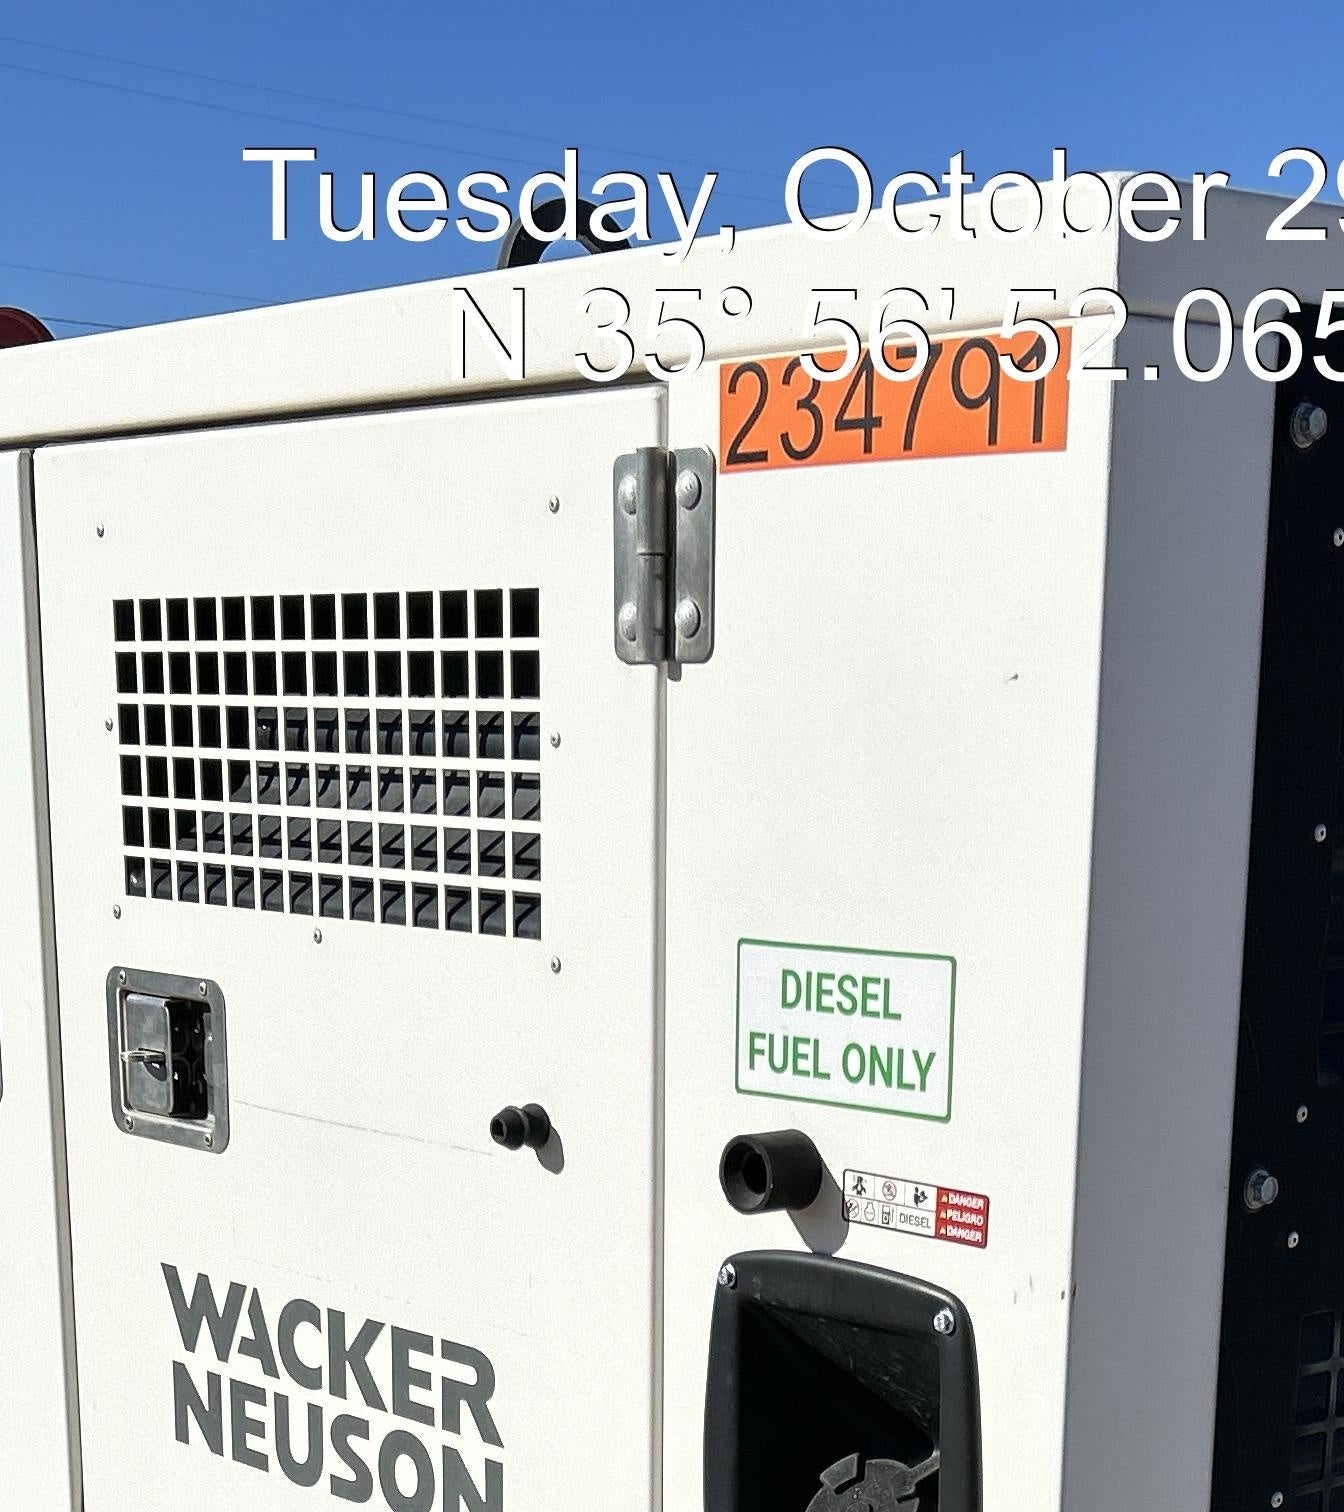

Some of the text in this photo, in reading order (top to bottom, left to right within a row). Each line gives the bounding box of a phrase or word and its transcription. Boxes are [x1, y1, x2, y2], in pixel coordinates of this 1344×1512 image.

[726, 332, 1046, 466] 234791
[781, 968, 902, 1021] DIESEL
[749, 1031, 936, 1092] FUEL ONLY
[947, 1208, 984, 1226] PELIGRO
[948, 1193, 985, 1210] DANGER
[899, 1213, 931, 1229] DIESEL
[947, 1225, 982, 1242] DANGER
[160, 1261, 505, 1449] WACKER
